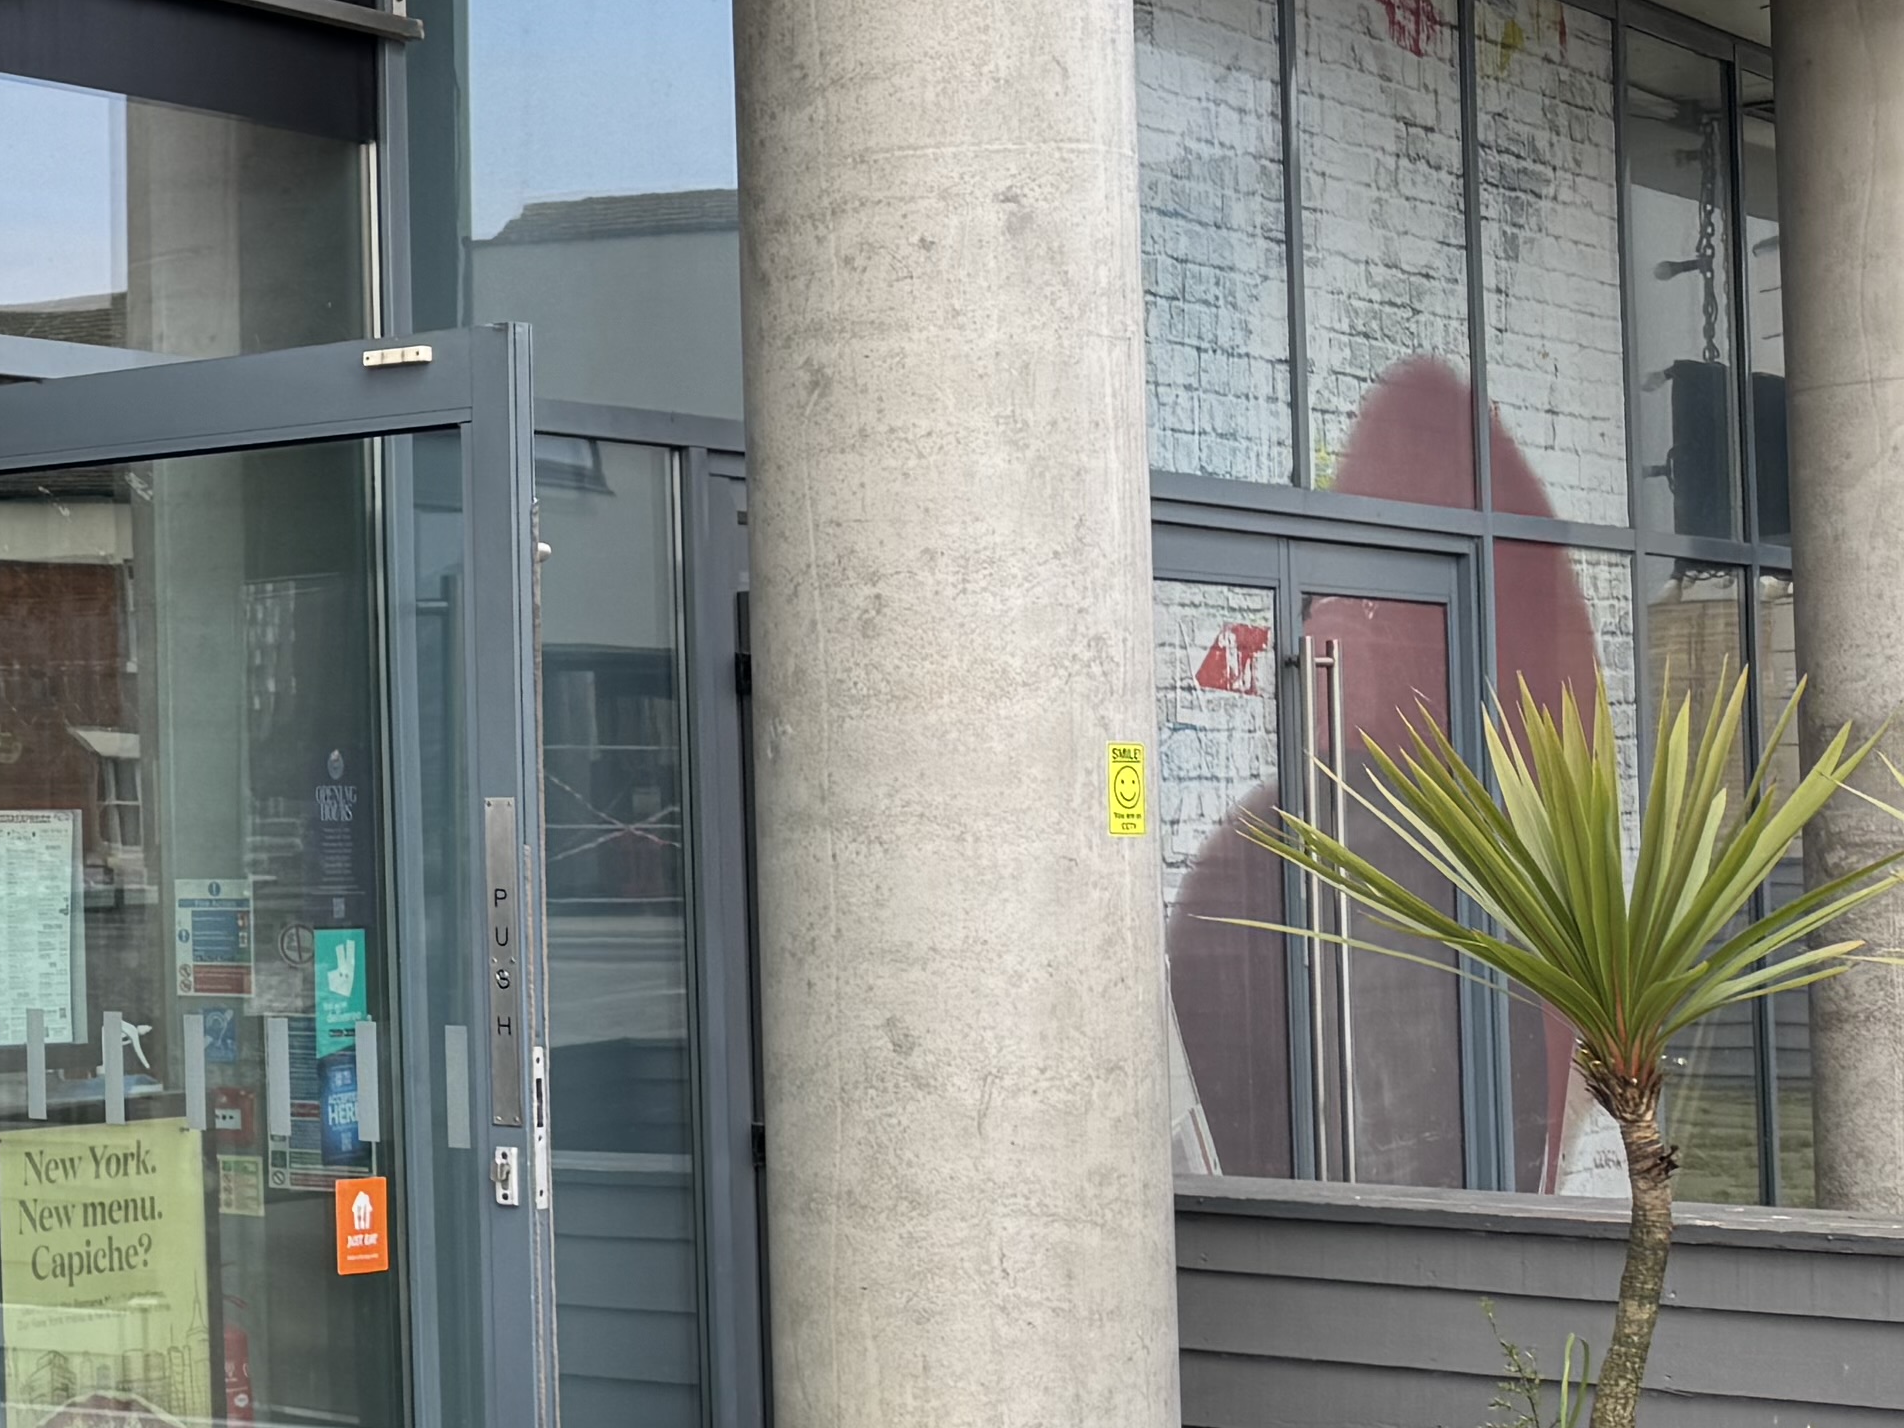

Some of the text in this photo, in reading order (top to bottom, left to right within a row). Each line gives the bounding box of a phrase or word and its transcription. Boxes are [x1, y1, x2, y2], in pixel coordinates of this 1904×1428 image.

[494, 888, 512, 1036] PUSH
[23, 1140, 157, 1186] New York.
[18, 1196, 163, 1235] New menu.
[31, 1232, 153, 1288] Capiche?
